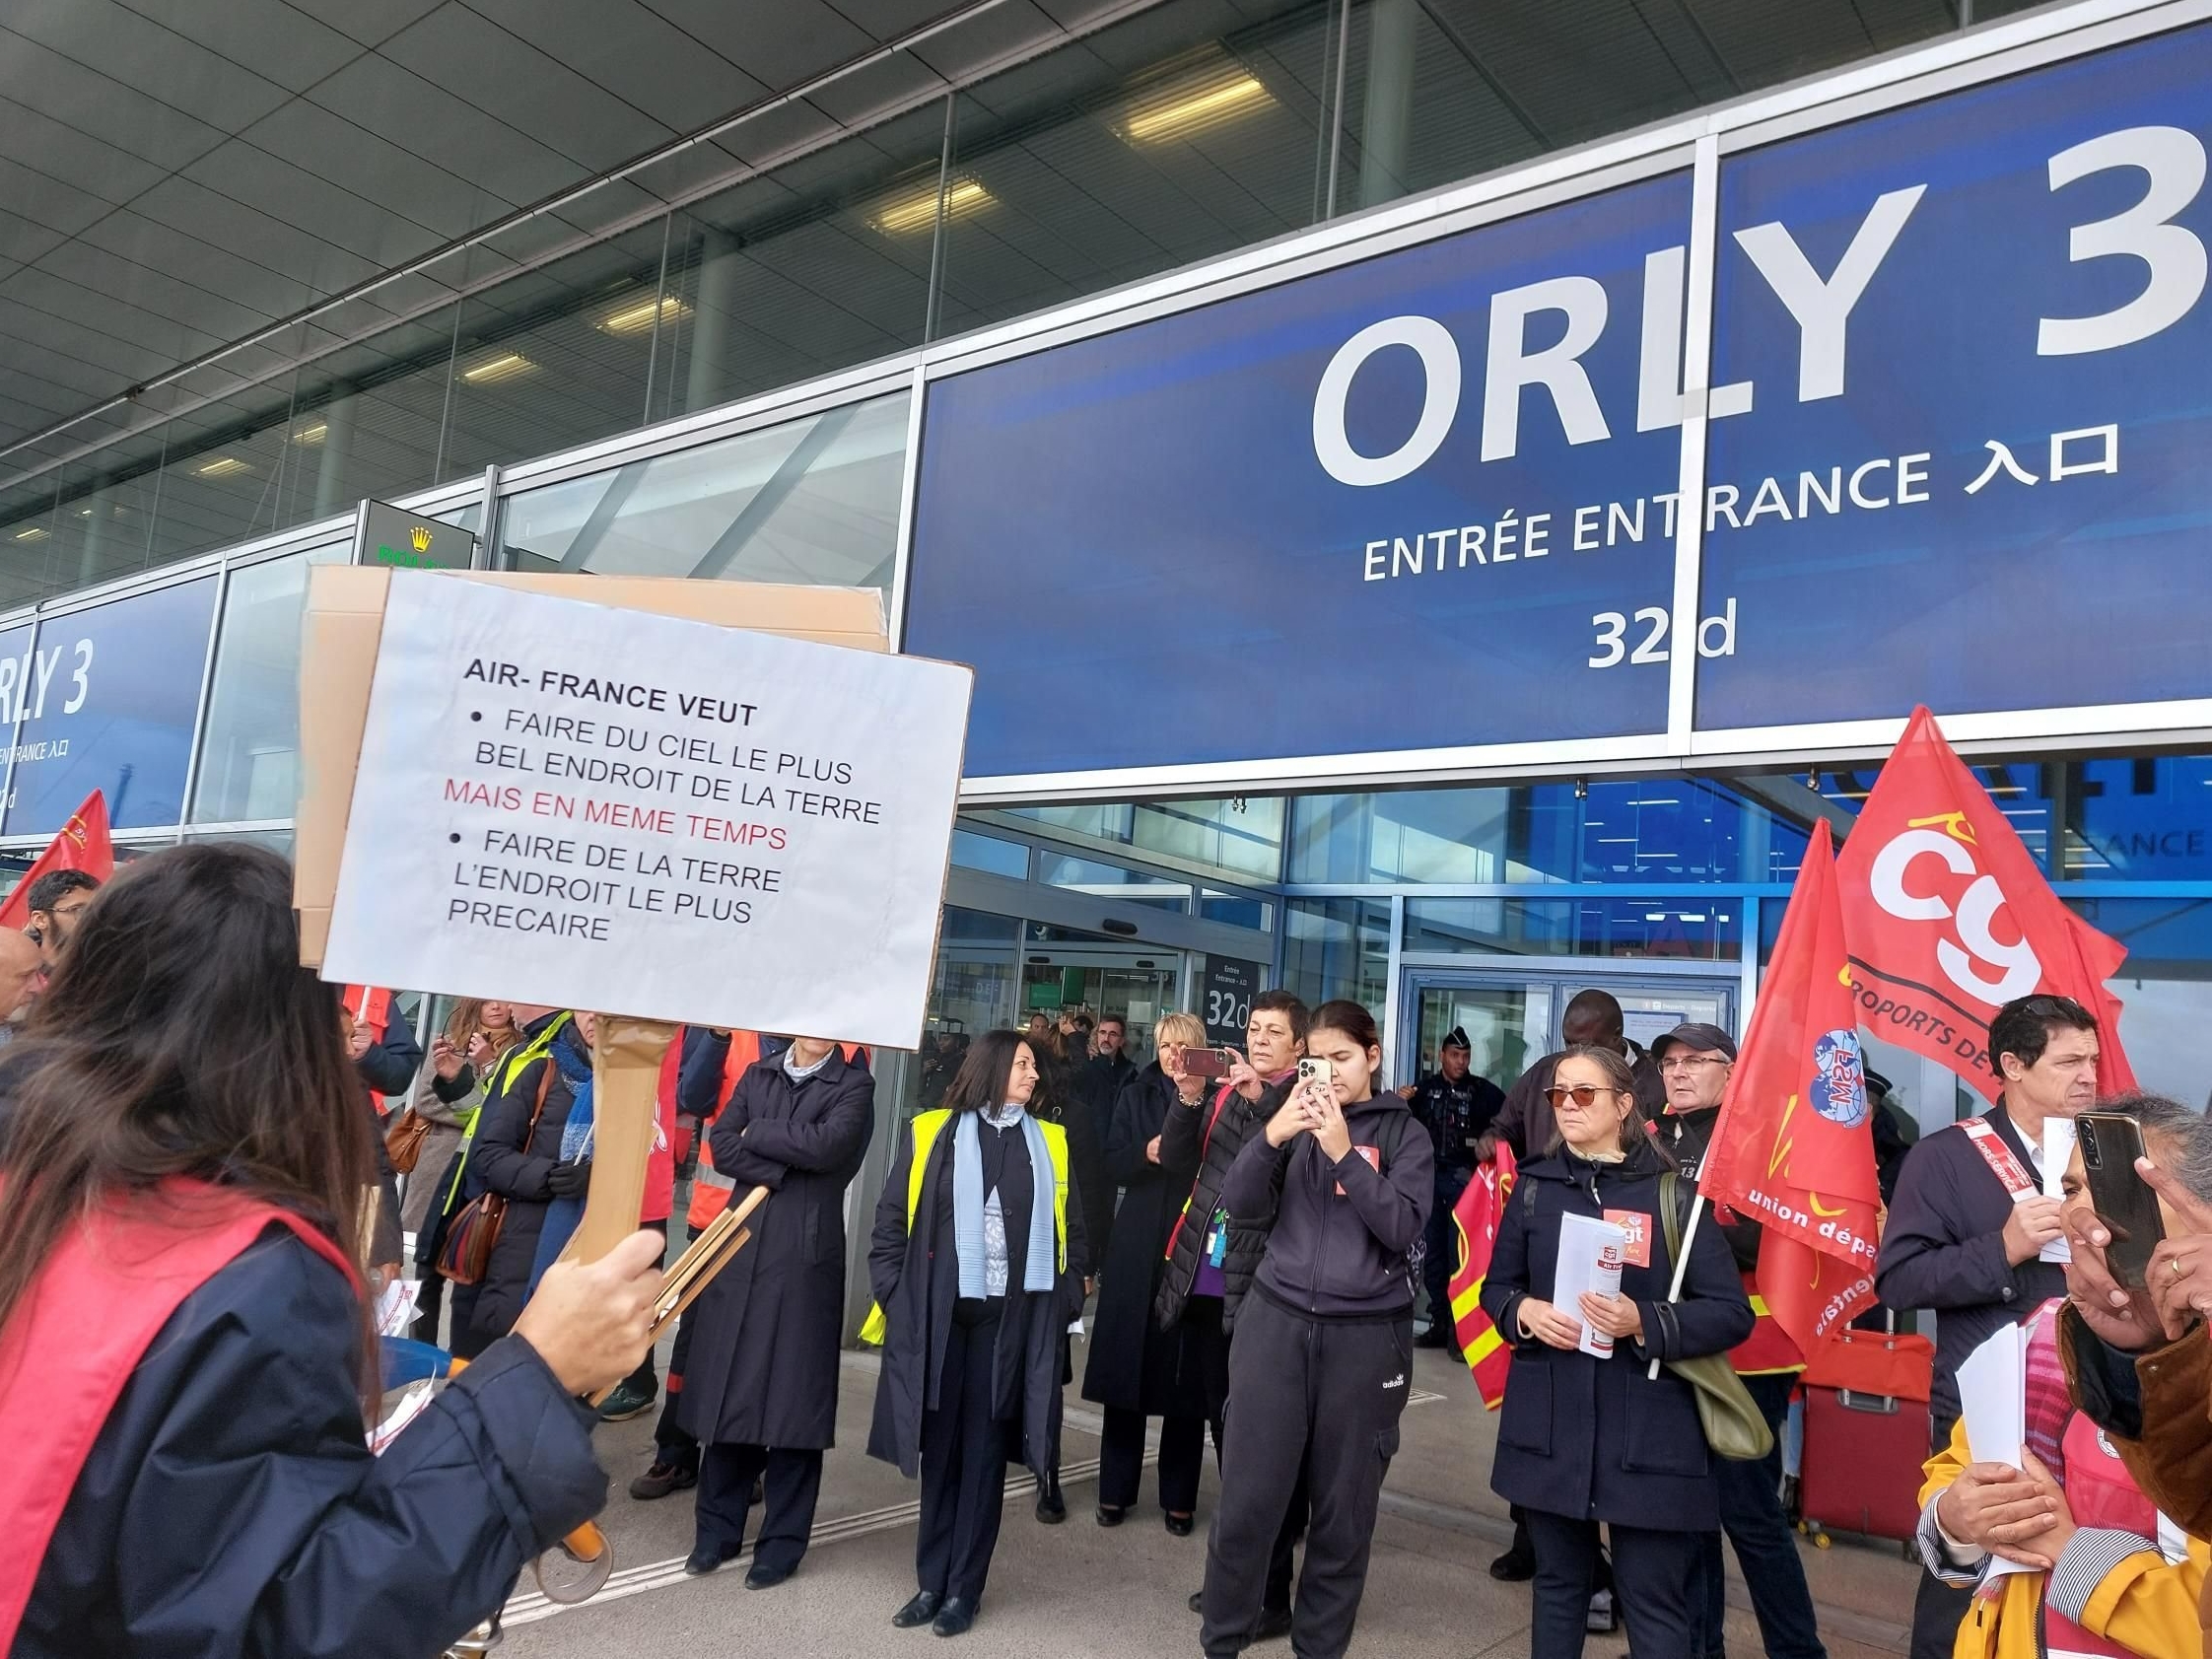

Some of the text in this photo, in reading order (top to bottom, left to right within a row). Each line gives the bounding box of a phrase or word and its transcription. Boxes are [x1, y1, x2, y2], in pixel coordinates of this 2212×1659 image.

[1312, 125, 2209, 488] ORLY 3
[1963, 424, 2120, 496] 入口
[1363, 452, 1931, 583] ENTRÉE ENTRANCE
[63, 638, 94, 715] 3
[463, 658, 757, 726] AIR- FRANCE VEUT
[47, 738, 69, 758] 入口
[475, 741, 882, 825] BEL ENDROIT DE LA TERRE
[505, 709, 853, 785] FAIRE DU CIEL LE PLUS
[444, 778, 788, 850] MAIS EN MEME TEMPS
[454, 863, 752, 924] L’ENDROIT LE PLUS
[484, 829, 782, 893] FAIRE DE LA TERRE
[449, 899, 611, 941] PRECAIRE
[1870, 828, 2042, 1007] cg
[1207, 990, 1251, 1029] 32d
[1851, 980, 1989, 1070] ROPORTS DE
[1973, 1138, 1996, 1160] HORS
[1990, 1159, 2019, 1193] SERVICE
[1624, 1226, 1643, 1244] gt
[1748, 1189, 1878, 1263] union dépa
[1382, 1380, 1404, 1389] adidas
